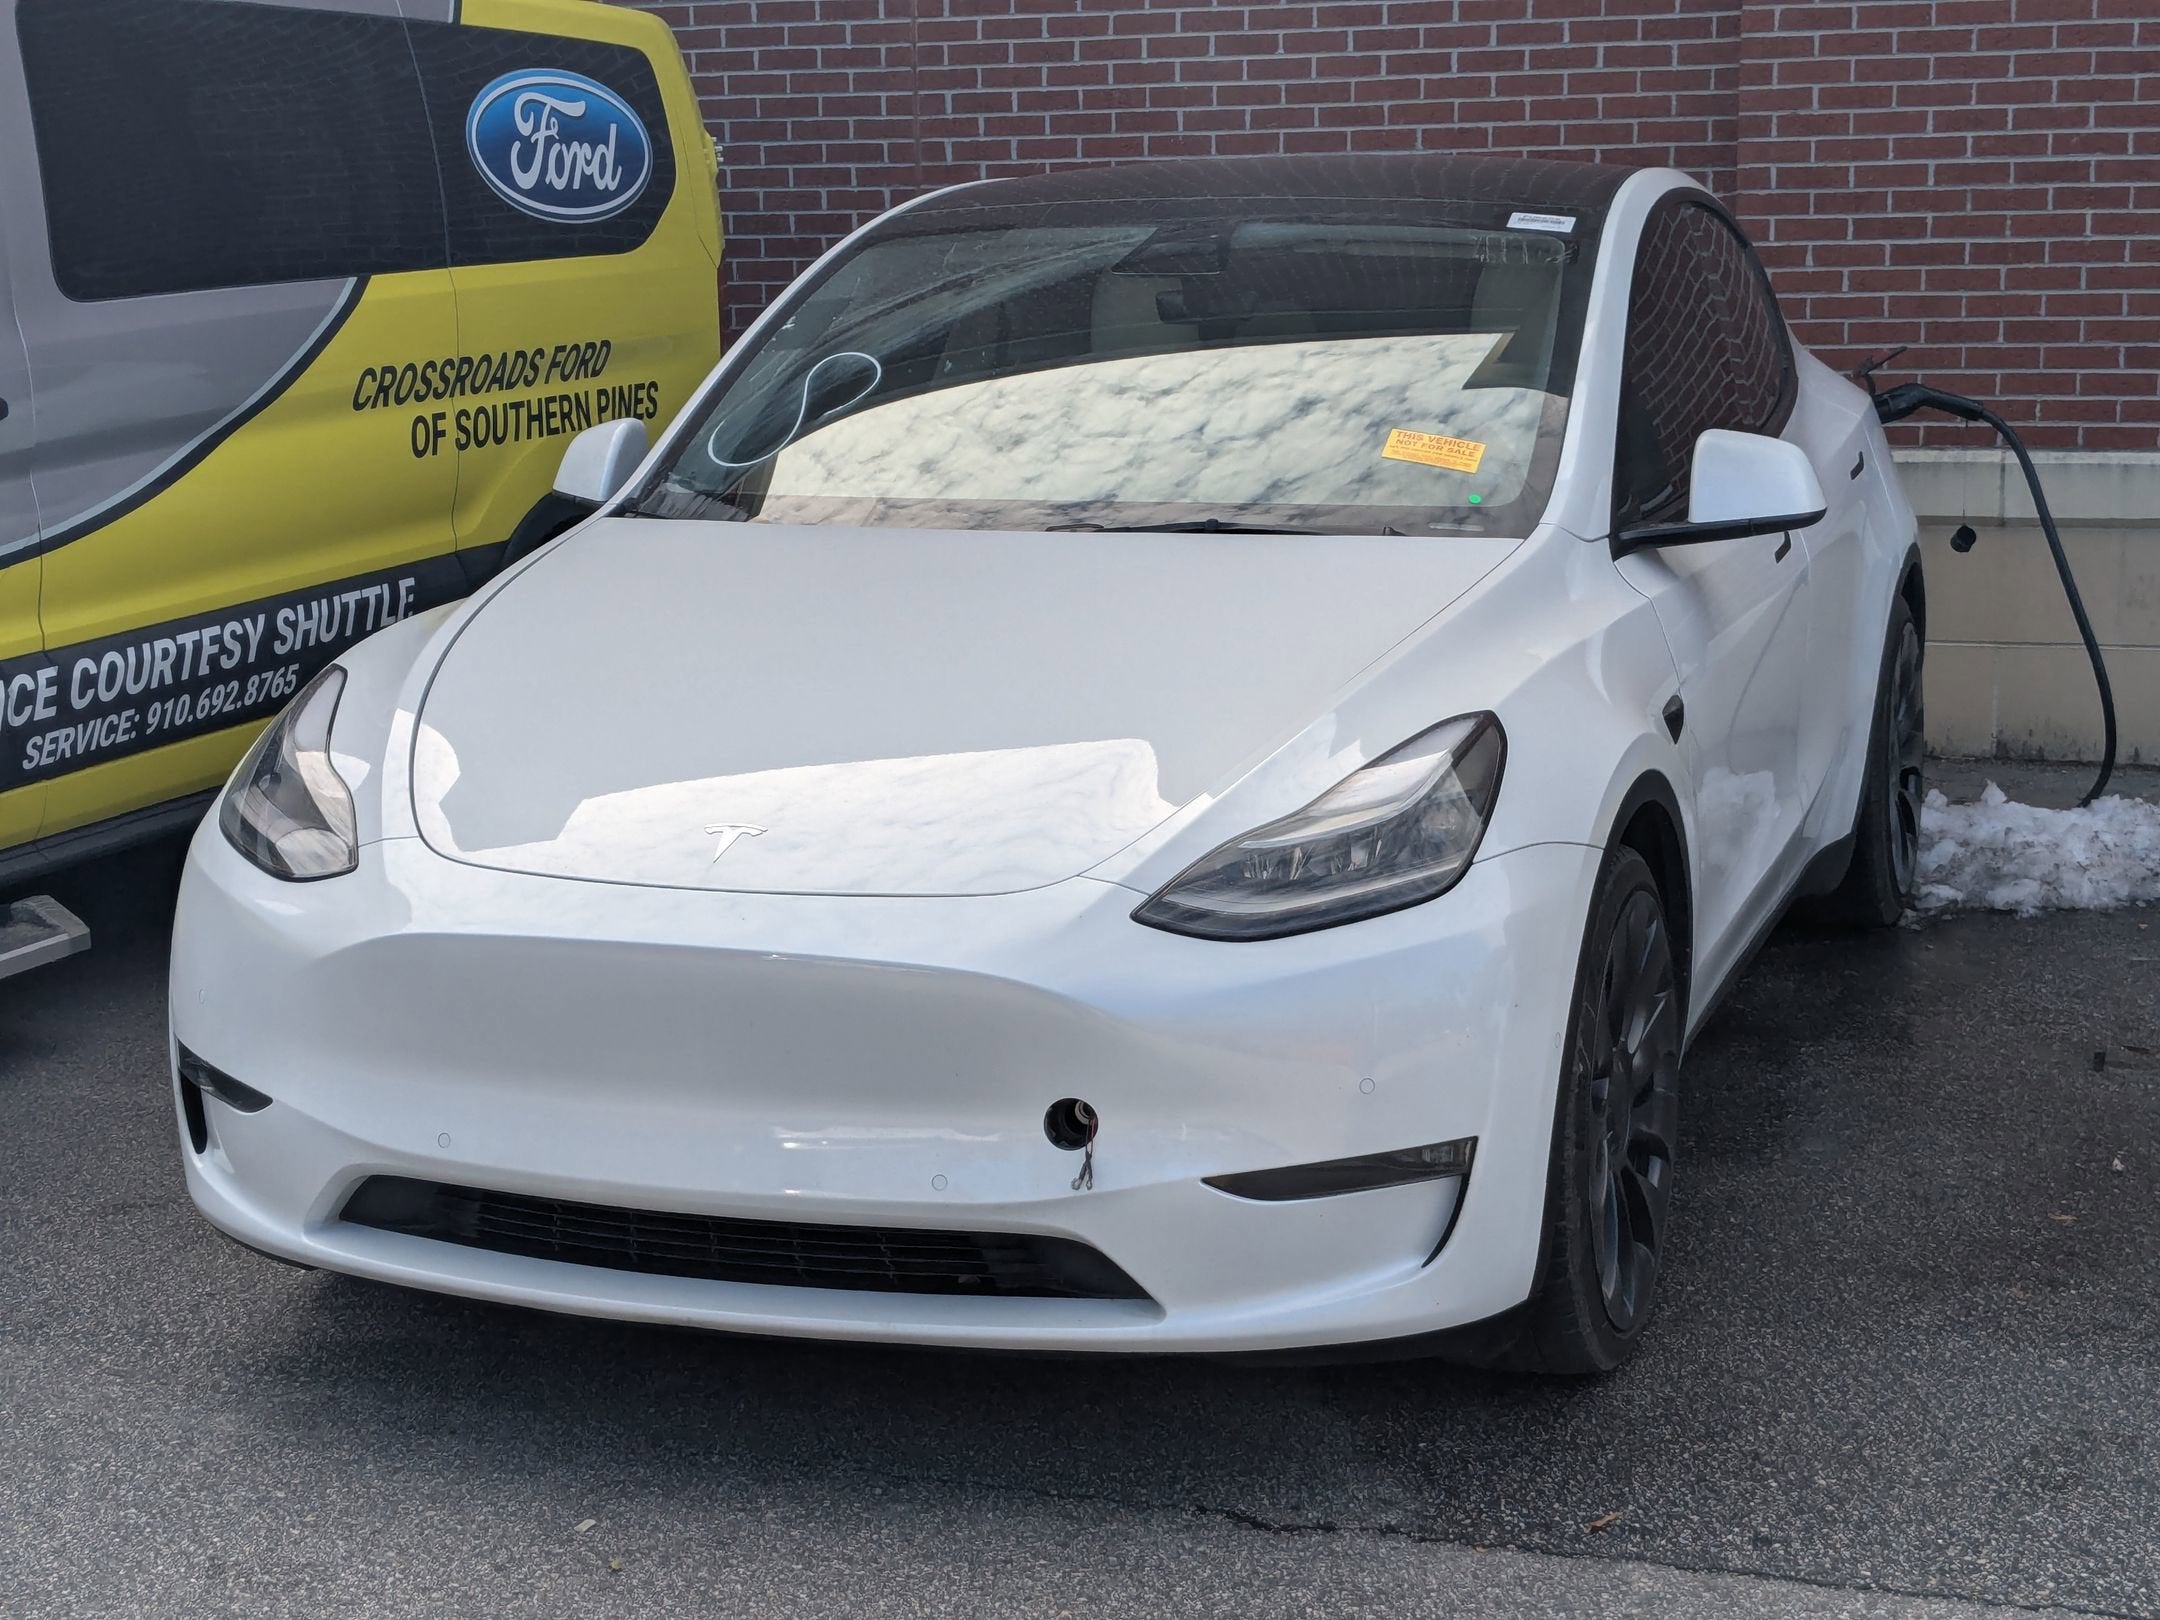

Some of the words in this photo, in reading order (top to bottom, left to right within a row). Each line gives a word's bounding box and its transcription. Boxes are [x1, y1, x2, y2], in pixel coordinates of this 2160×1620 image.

[511, 92, 622, 191] Ford
[352, 347, 545, 411] CROSSROADS
[544, 339, 612, 384] FORD
[411, 411, 447, 459] OF
[455, 390, 592, 451] SOUTHERN
[597, 380, 659, 421] PINES
[1395, 439, 1418, 447] NOT
[1420, 442, 1444, 452] FOR
[1446, 447, 1475, 458] SALE
[1396, 431, 1424, 441] THIS
[1428, 436, 1481, 452] VEHICLE
[274, 577, 416, 656] SHUTTLE
[22, 708, 140, 770] SERVICE:
[146, 663, 300, 735] 910.692.8765
